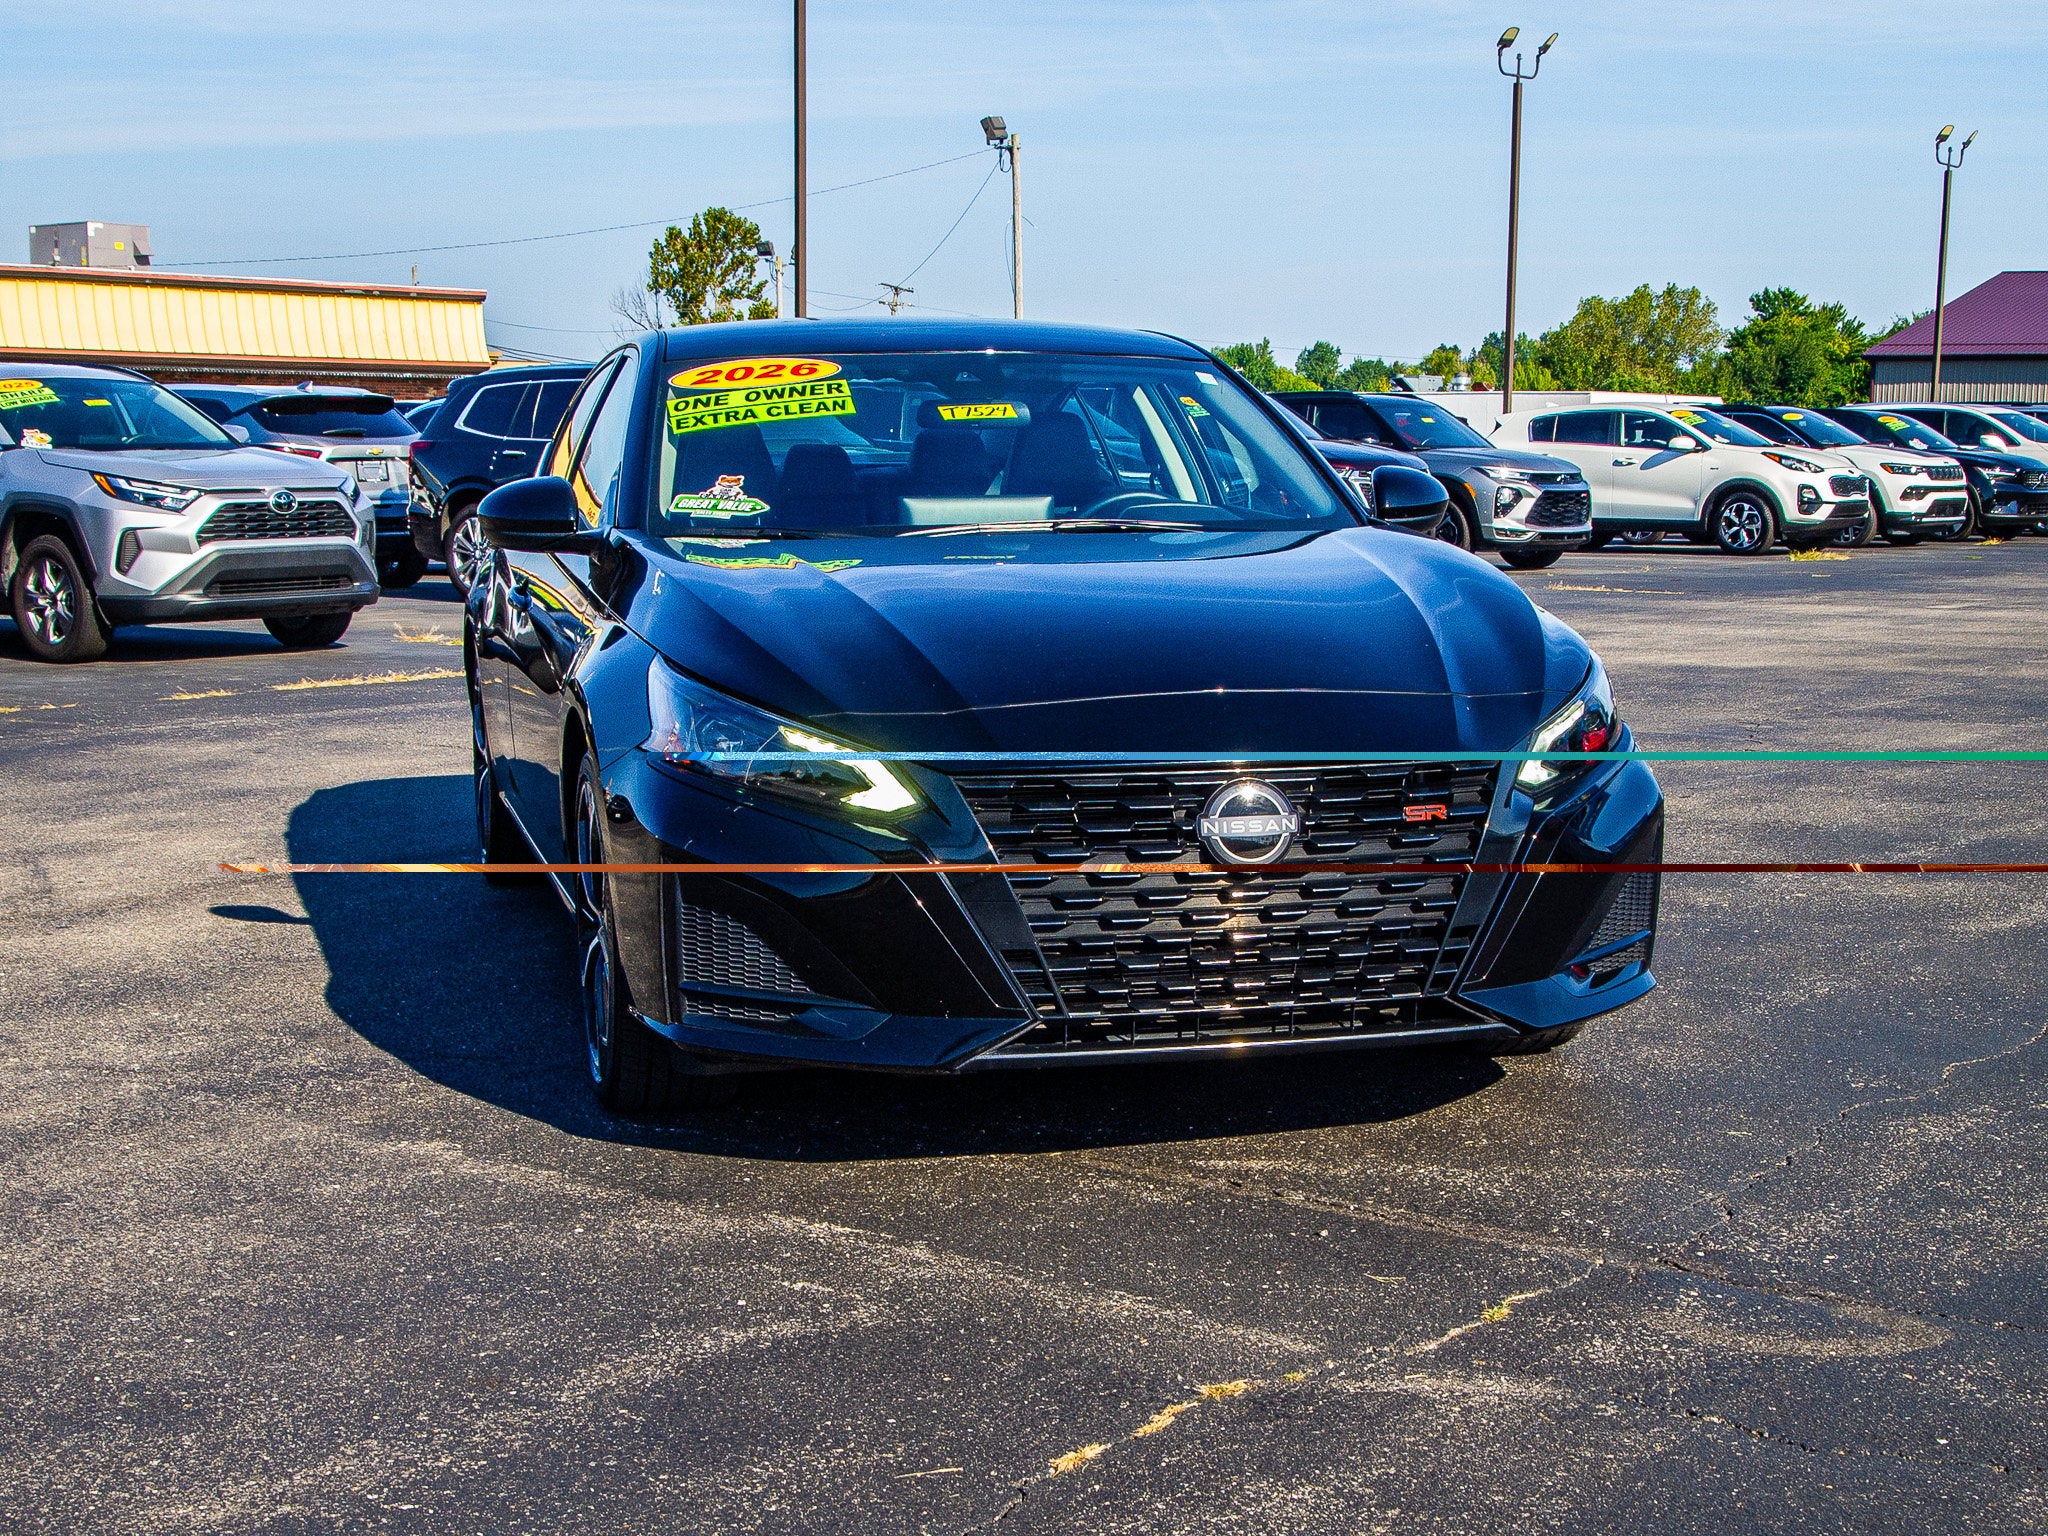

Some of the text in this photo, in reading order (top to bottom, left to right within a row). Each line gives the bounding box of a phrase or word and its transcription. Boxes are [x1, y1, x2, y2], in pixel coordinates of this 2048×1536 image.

[690, 363, 821, 386] 2026
[0, 382, 35, 390] 025
[673, 382, 844, 413] ONE OWNER
[675, 399, 847, 430] EXTRA CLEAN
[943, 406, 1007, 418] T7524
[678, 499, 755, 511] GREAT VALUE
[1404, 804, 1447, 822] SR
[1202, 817, 1297, 835] NISSAN
